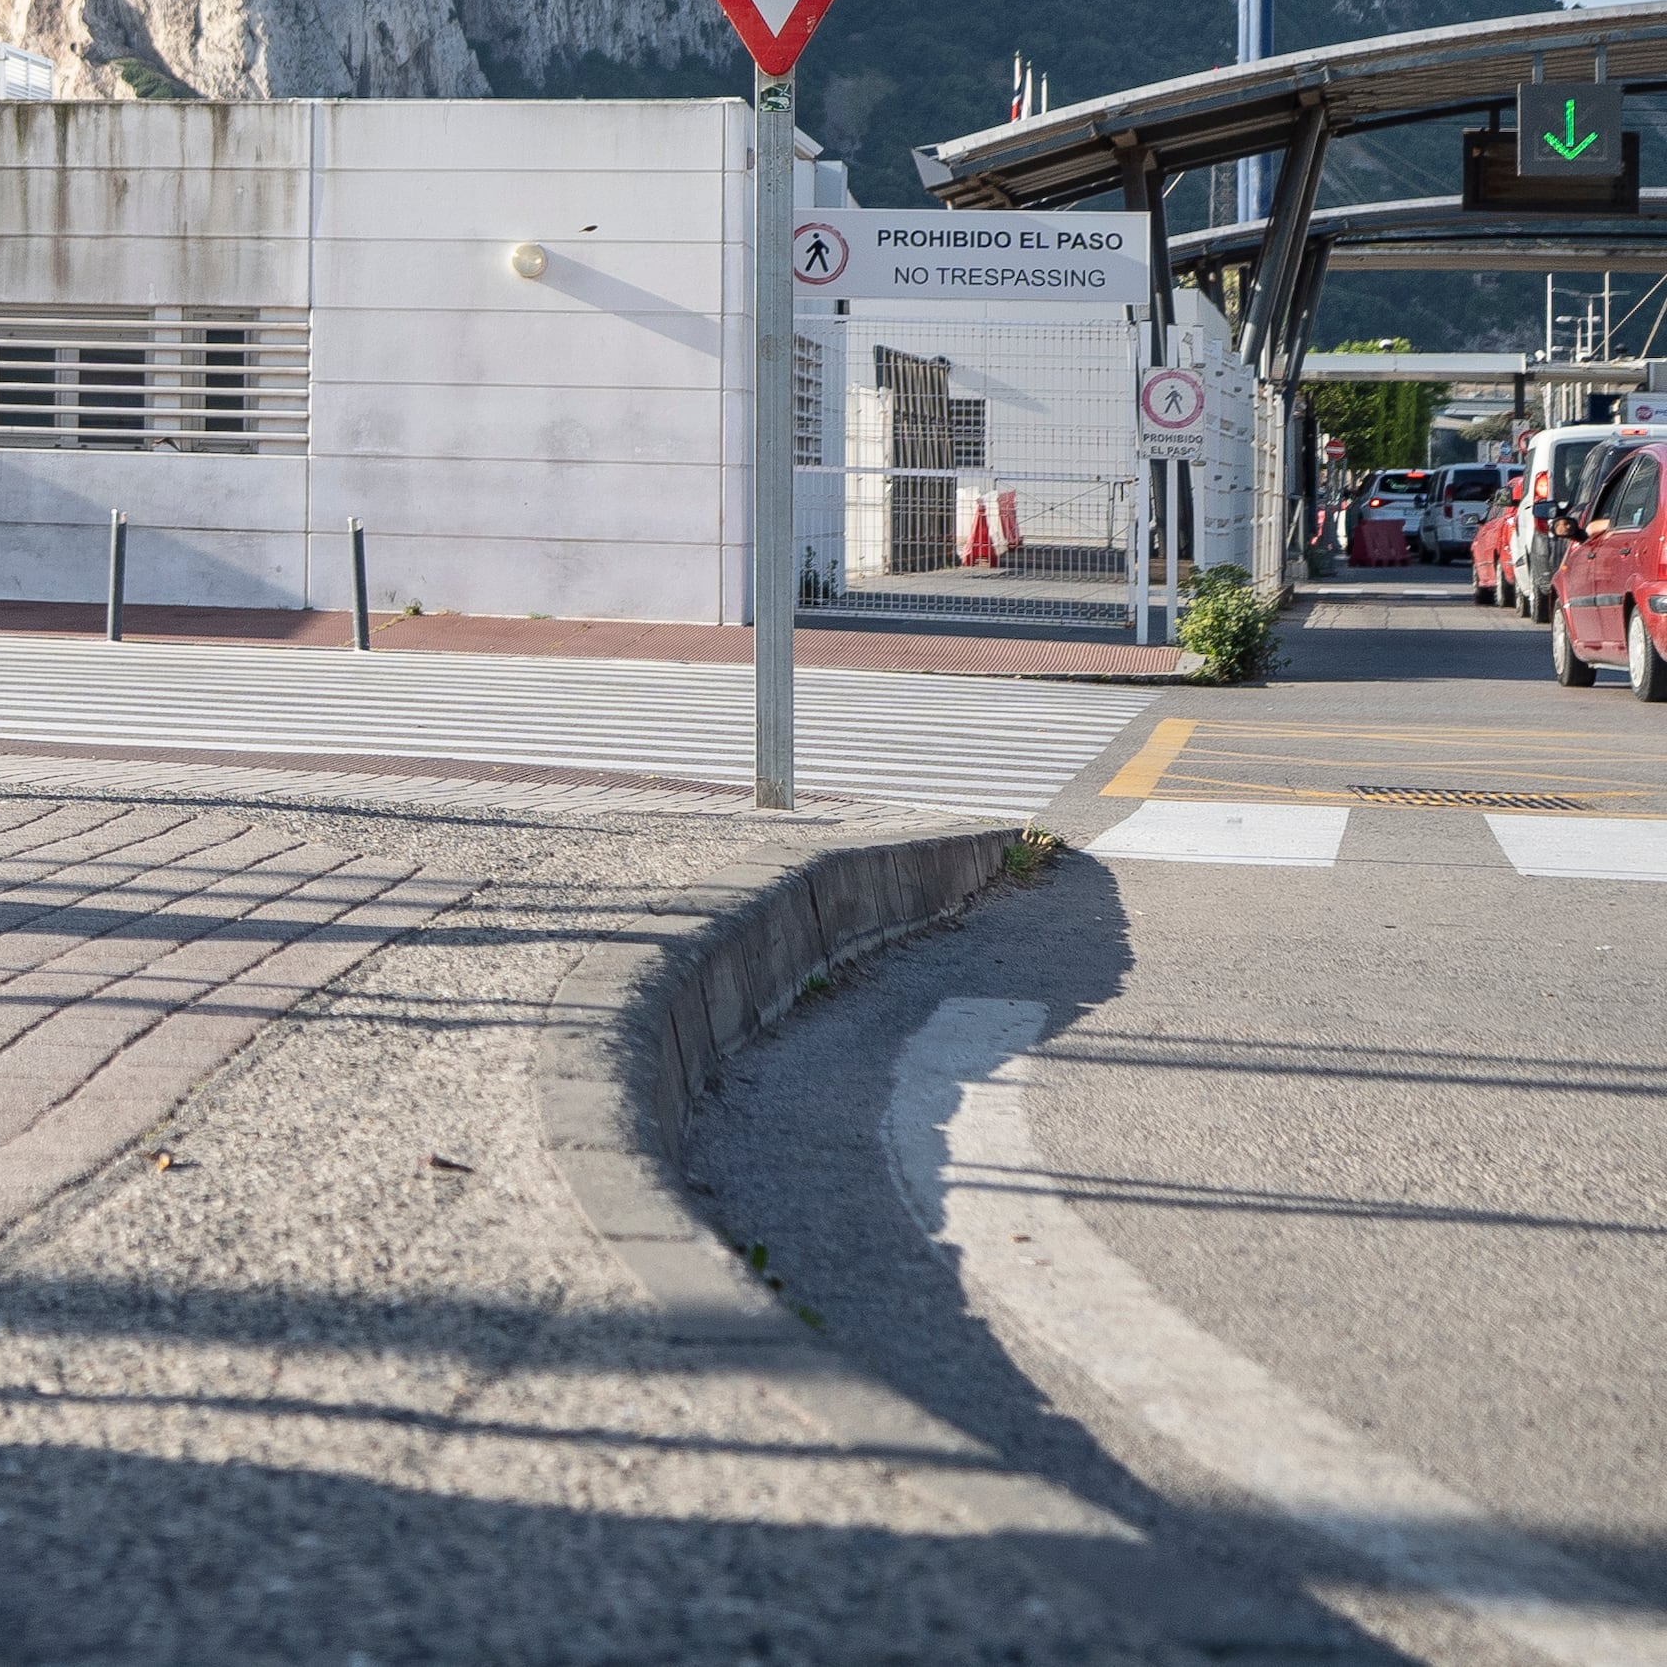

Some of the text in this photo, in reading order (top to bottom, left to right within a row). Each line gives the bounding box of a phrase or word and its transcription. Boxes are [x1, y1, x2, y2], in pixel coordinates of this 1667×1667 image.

[877, 229, 1123, 250] PROHIBIDO EL PASO
[894, 267, 1106, 287] NO TRESPASSING
[1143, 433, 1203, 444] PROHIBIDO
[1151, 445, 1164, 454] EL
